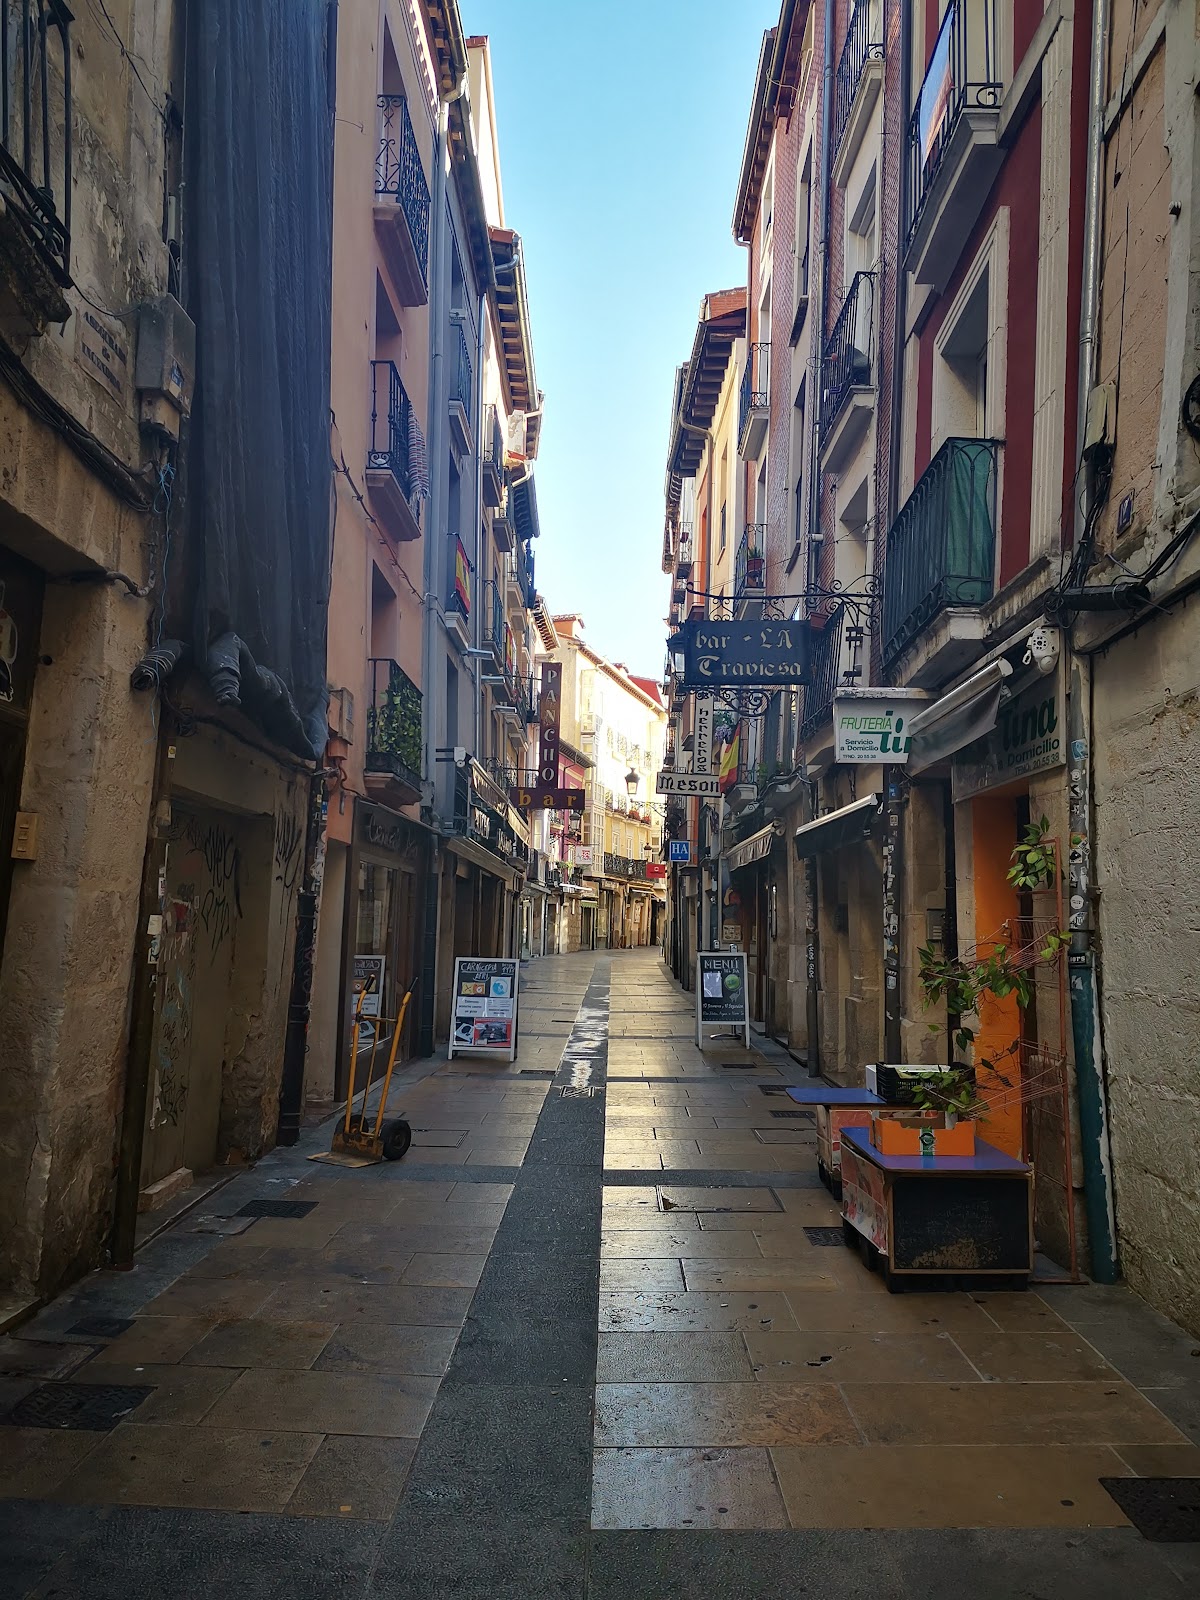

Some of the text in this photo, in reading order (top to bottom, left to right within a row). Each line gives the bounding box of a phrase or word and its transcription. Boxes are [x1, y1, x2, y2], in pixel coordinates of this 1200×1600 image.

[696, 630, 731, 648] bar
[760, 627, 793, 649] LA
[541, 670, 558, 781] PANCHO
[840, 717, 892, 730] FRUTERIA
[697, 707, 709, 772] herreros
[1008, 738, 1060, 767] Domicilio
[658, 776, 719, 792] Meson
[517, 789, 577, 806] bar
[671, 843, 688, 854] HA
